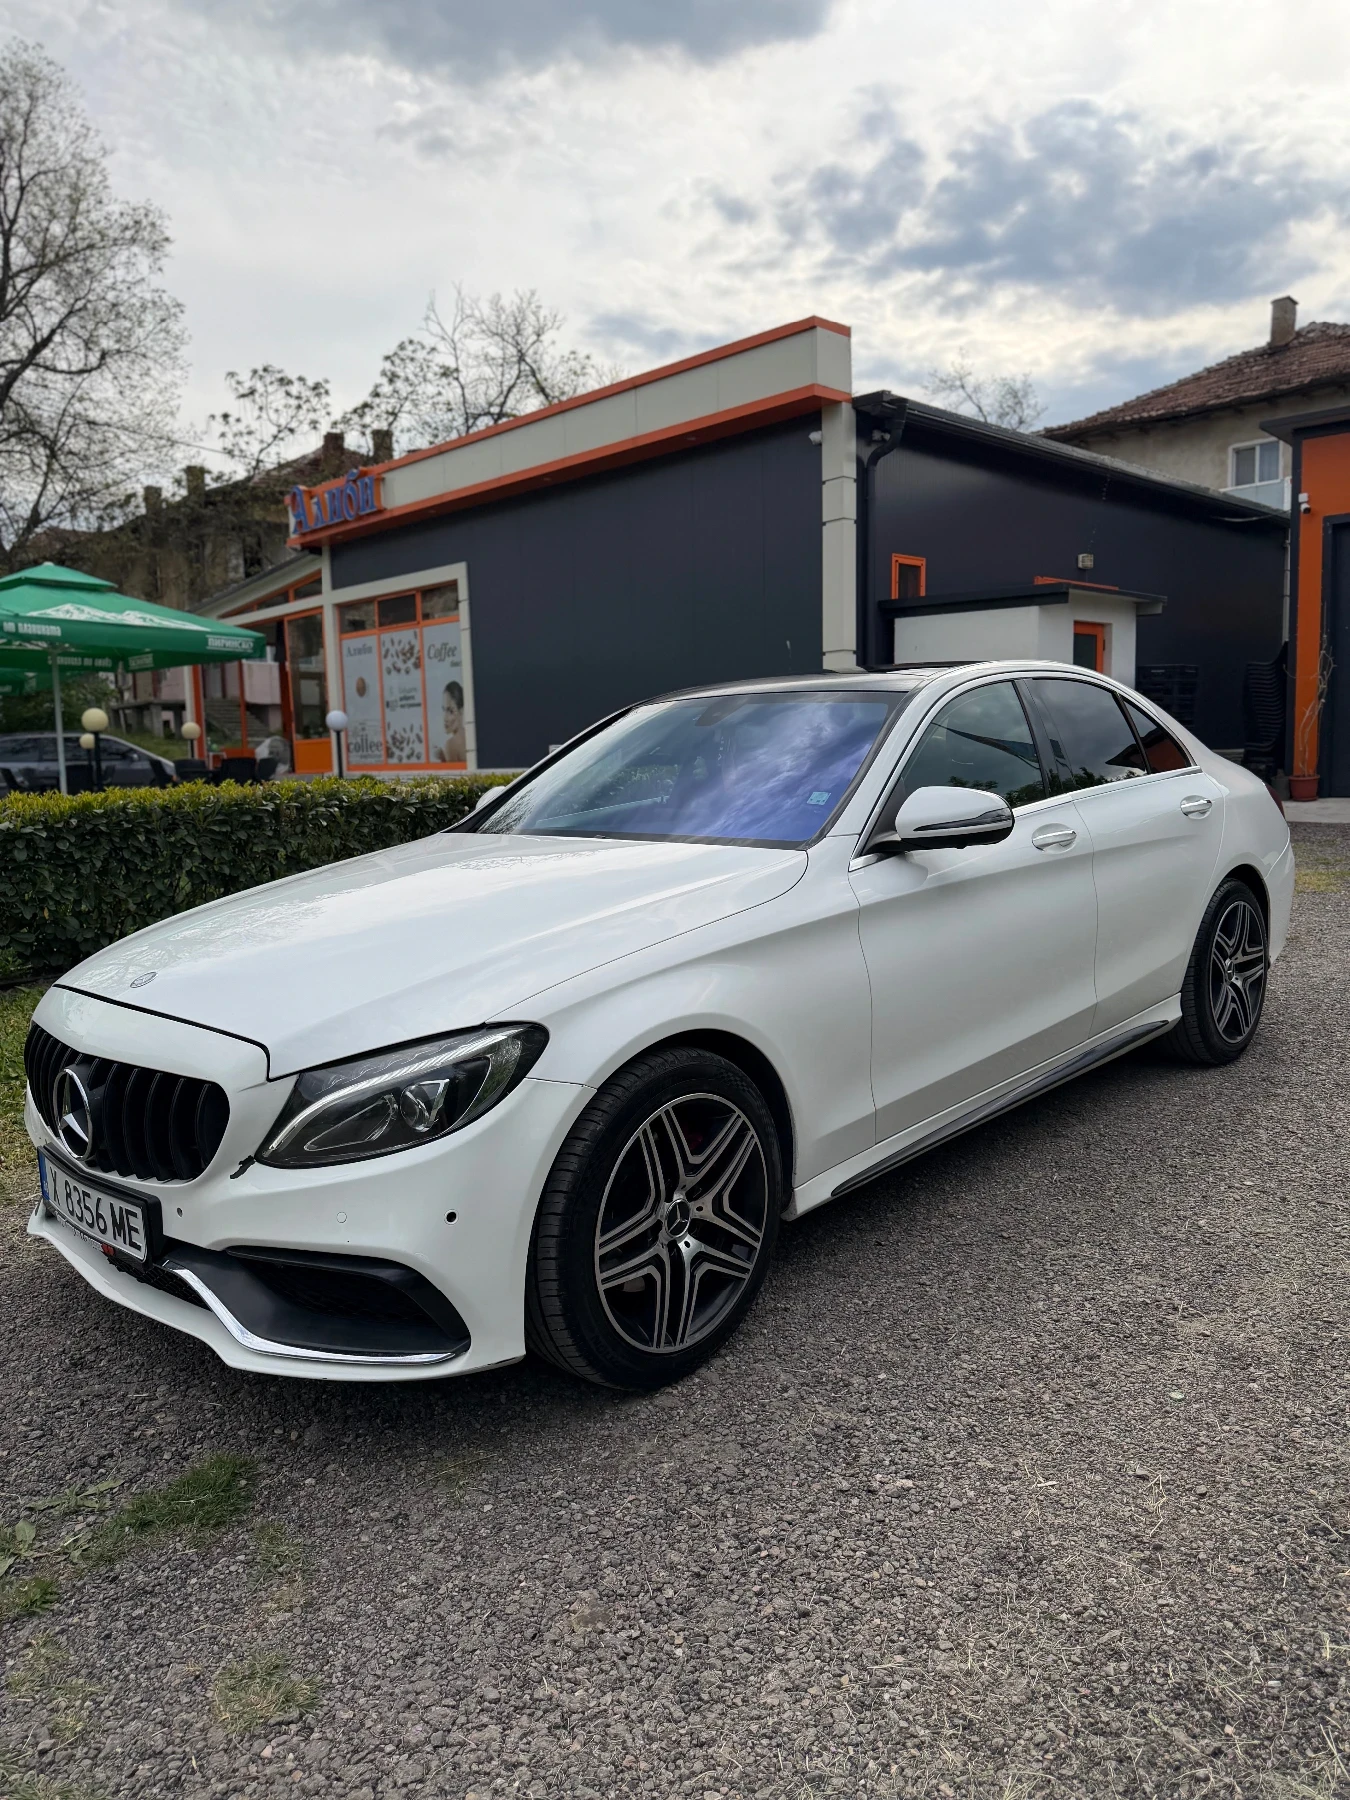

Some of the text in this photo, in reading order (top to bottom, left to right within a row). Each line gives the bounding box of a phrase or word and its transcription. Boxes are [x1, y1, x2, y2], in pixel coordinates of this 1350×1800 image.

[292, 468, 377, 535] Алиби
[427, 643, 457, 662] Coffee
[49, 1166, 61, 1206] X
[64, 1179, 107, 1235] 8356
[109, 1201, 142, 1252] ME
